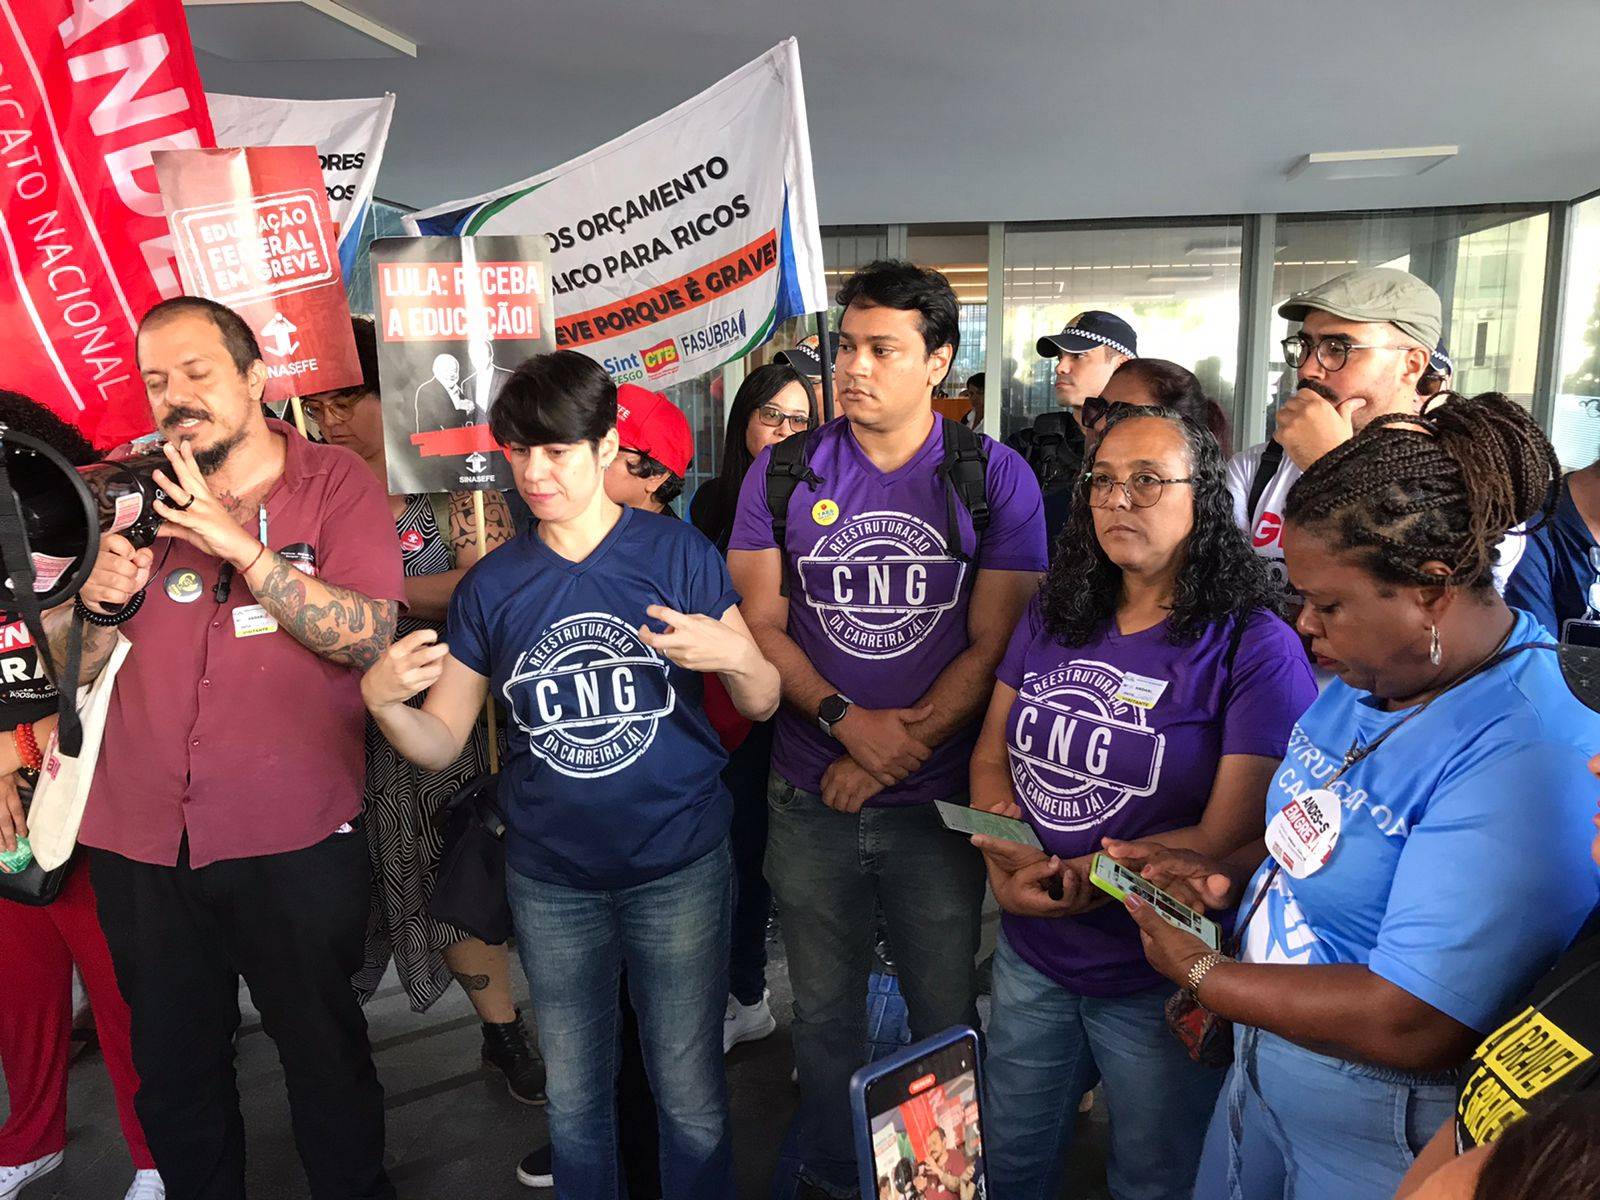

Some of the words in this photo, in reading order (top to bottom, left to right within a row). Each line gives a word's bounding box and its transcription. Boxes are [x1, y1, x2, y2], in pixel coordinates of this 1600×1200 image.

[576, 155, 729, 235] ORÇAMENTO
[552, 263, 602, 296] LICO
[602, 236, 673, 278] PARA
[670, 193, 751, 250] RICOS
[213, 270, 250, 292] EM
[256, 250, 321, 282] GREVE
[383, 266, 448, 298] LULA:
[453, 265, 542, 296] RCEBA
[593, 288, 686, 336] PORQUE
[705, 238, 777, 294] GRAVE!
[27, 209, 131, 401] NACIONAL
[387, 307, 404, 337] A
[407, 301, 534, 341] EDUCÇÃO!
[644, 345, 677, 368] CTB
[681, 316, 729, 357] FASUBRA
[603, 352, 640, 375] Sint
[459, 474, 496, 484] SINASEFE
[829, 520, 931, 554] REESTRUTURAÇÃO
[529, 623, 634, 668] REESTRUTURAÇÃO
[829, 614, 844, 632] DA
[844, 626, 906, 648] CARREIRA
[907, 618, 926, 638] JÁ!
[543, 734, 559, 754] DA
[560, 745, 624, 765] CARREIRA
[626, 727, 645, 750] JÁ!
[1015, 763, 1026, 784] DA
[1026, 782, 1081, 818] CARREIRA
[1085, 792, 1106, 814] JÁ!
[1496, 1025, 1578, 1091] GRAVE!
